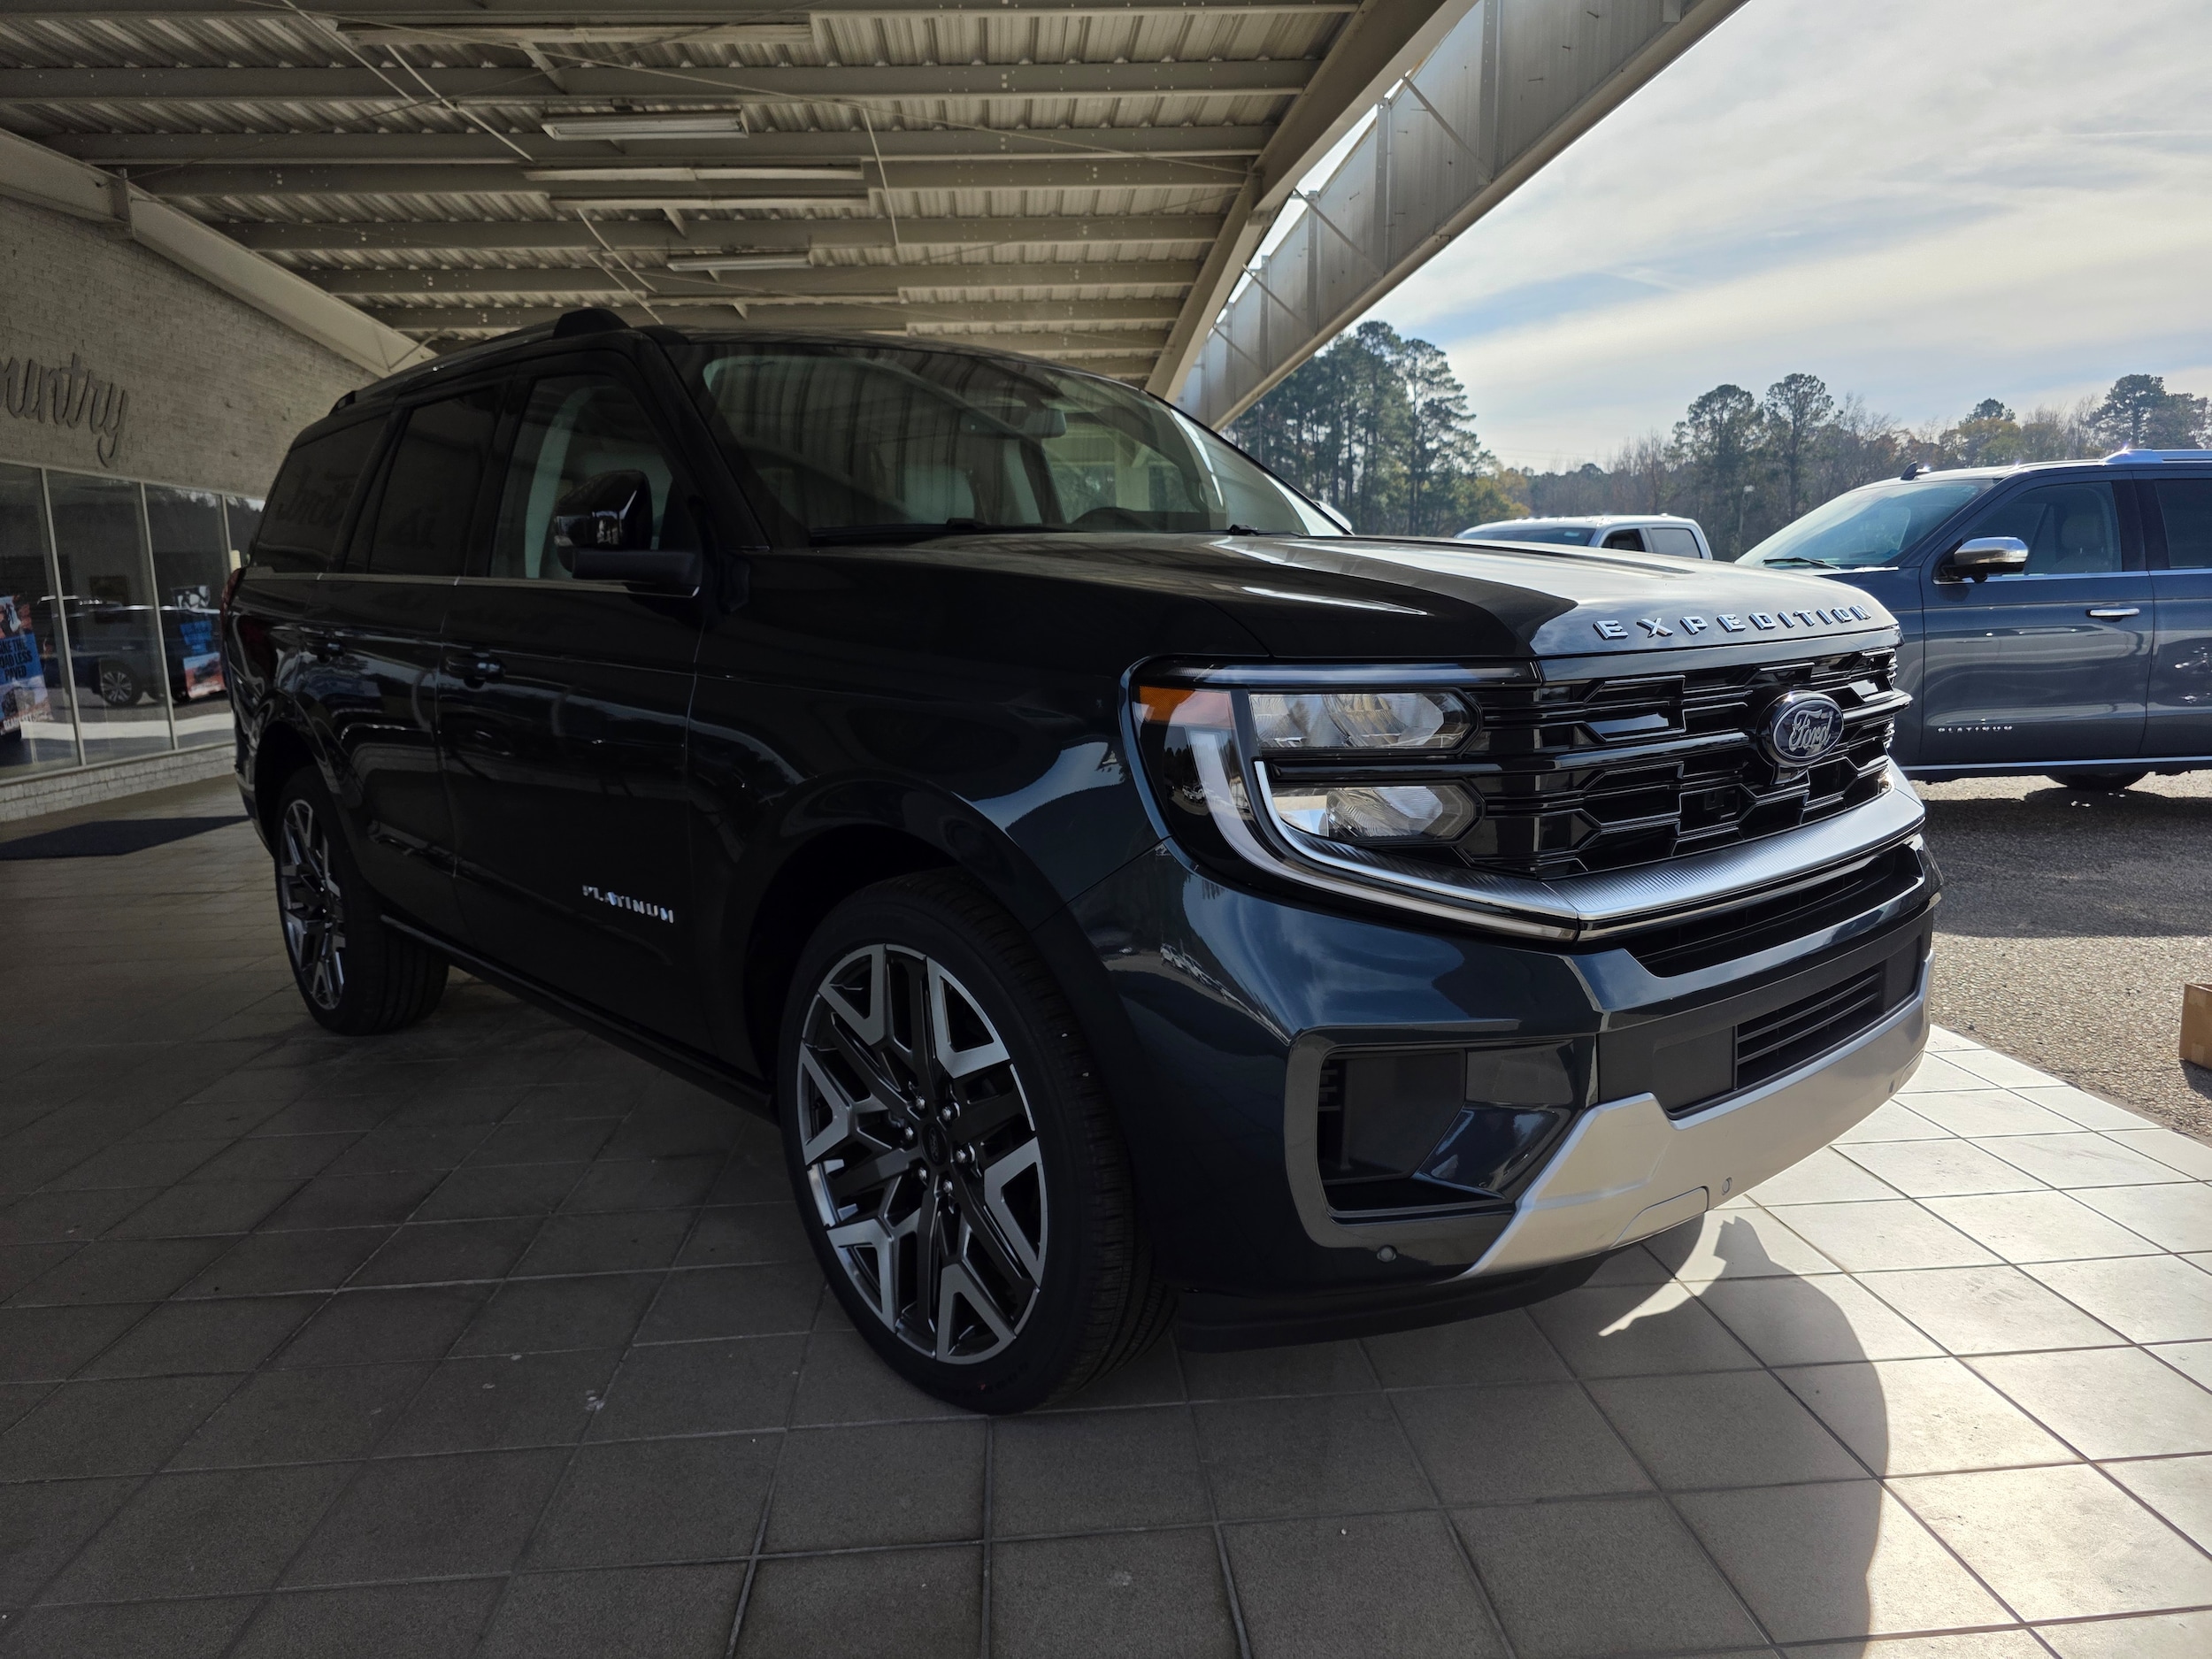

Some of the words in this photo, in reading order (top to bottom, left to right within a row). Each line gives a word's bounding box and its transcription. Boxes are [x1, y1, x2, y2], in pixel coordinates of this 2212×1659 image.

[0, 353, 130, 468] untry
[1593, 604, 1872, 641] EXPEDITION
[14, 650, 34, 665] LESS
[1786, 708, 1834, 753] Ford
[582, 885, 674, 924] PLATINUM
